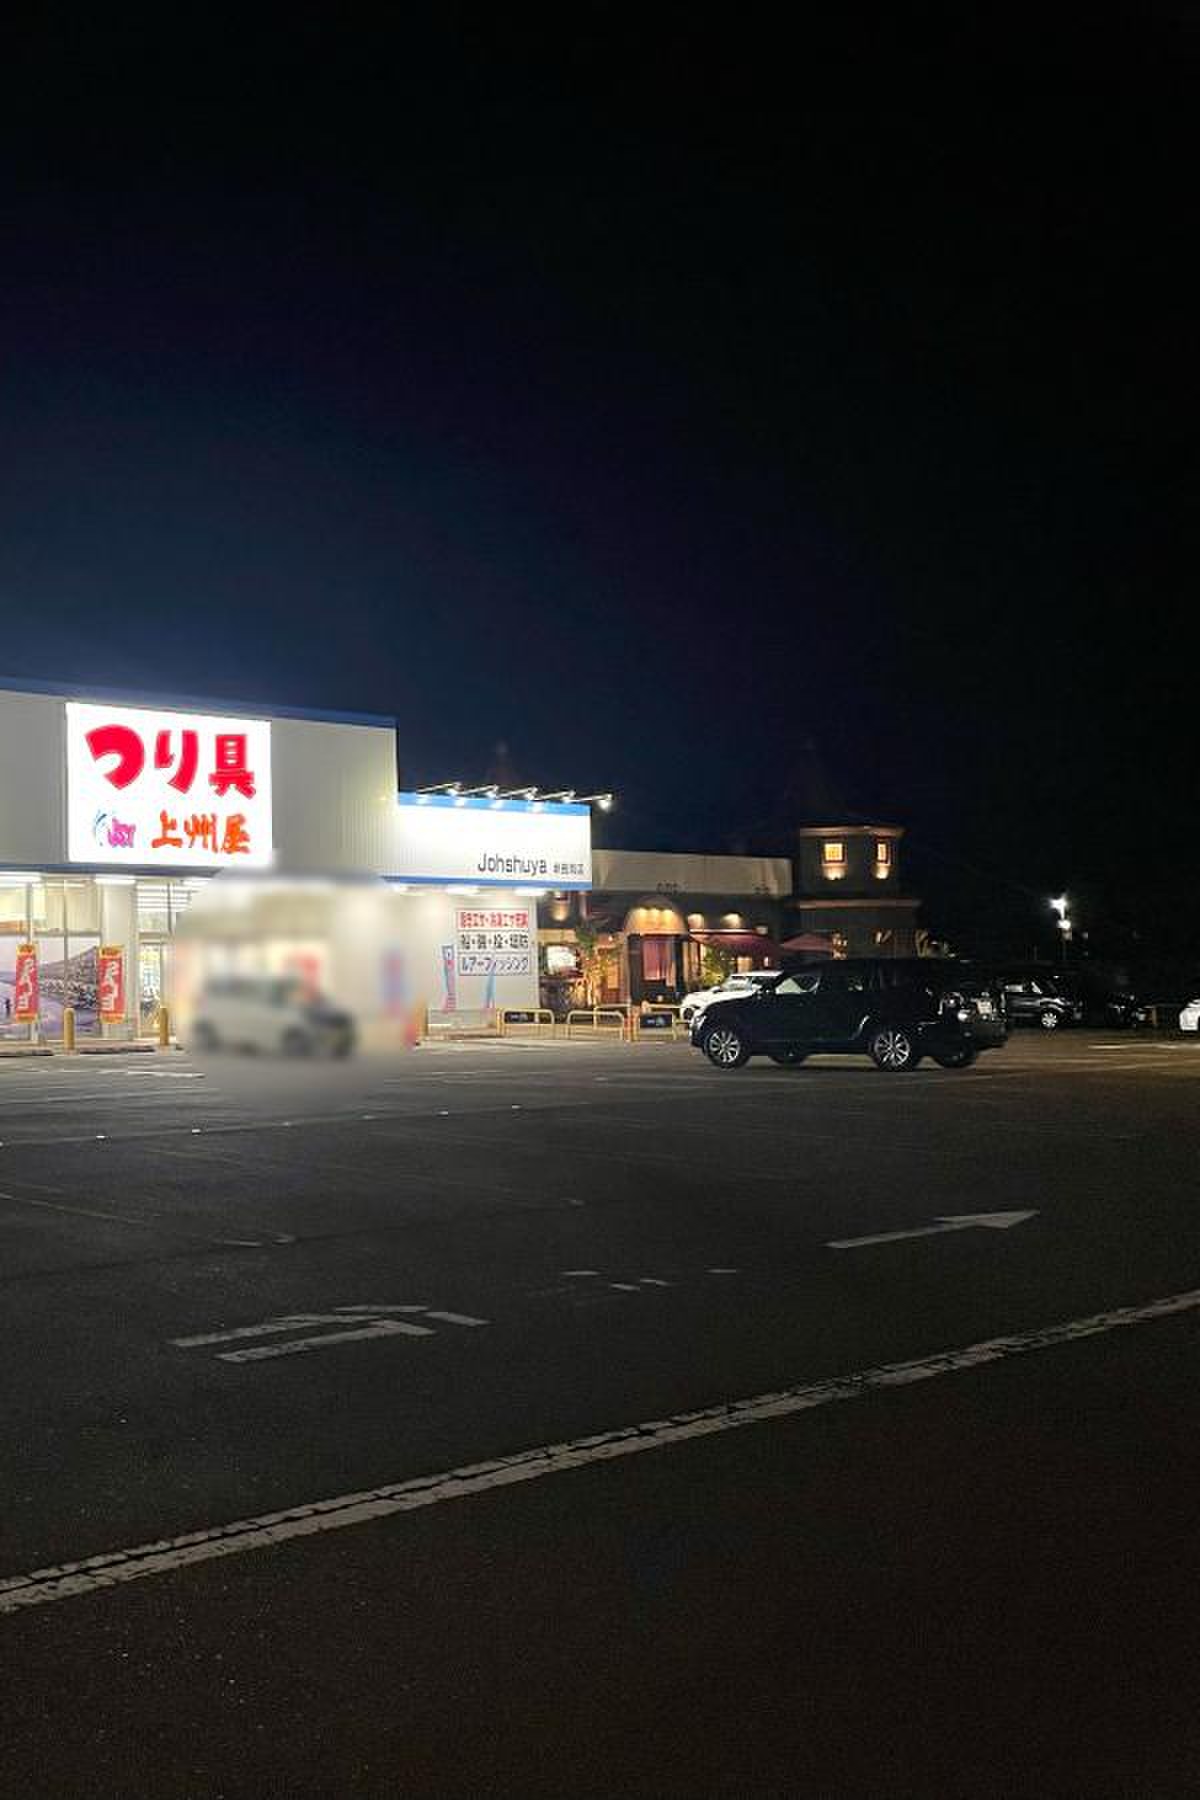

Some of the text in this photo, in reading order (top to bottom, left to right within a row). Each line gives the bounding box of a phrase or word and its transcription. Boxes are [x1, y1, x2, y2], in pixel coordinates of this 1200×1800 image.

[84, 724, 256, 799] つり具
[151, 809, 251, 854] 上州屋
[477, 853, 548, 876] Johshuya
